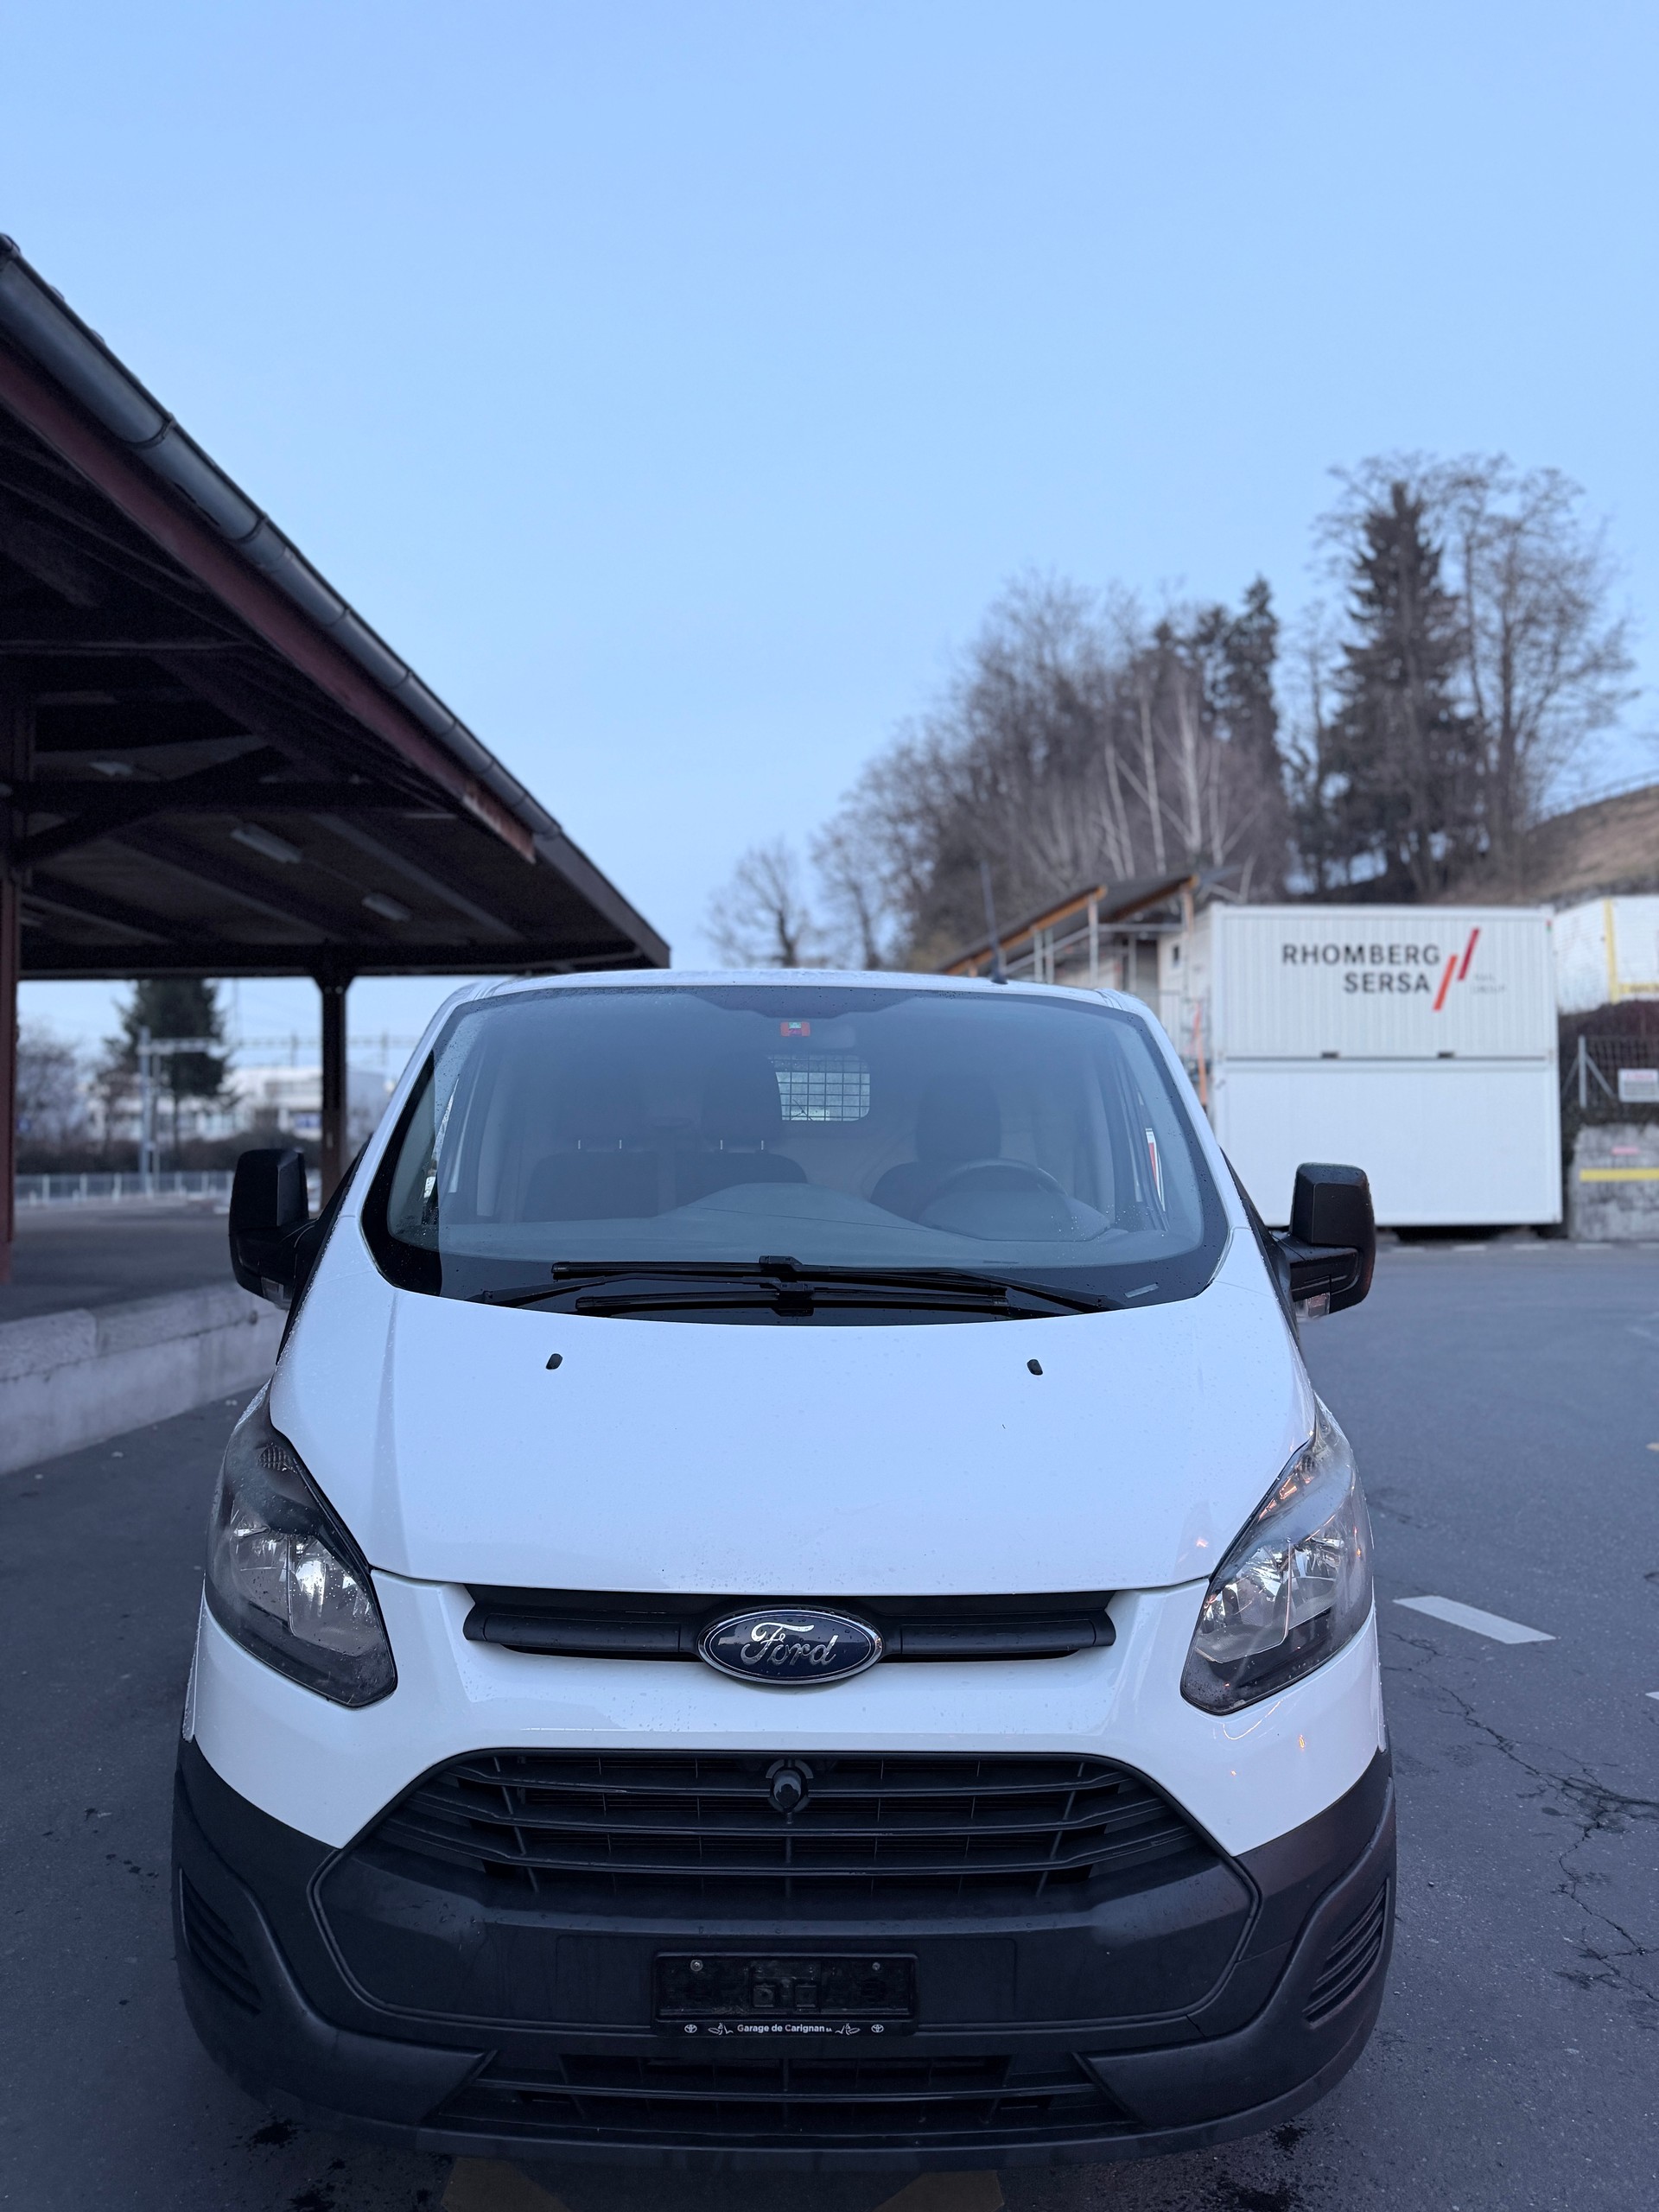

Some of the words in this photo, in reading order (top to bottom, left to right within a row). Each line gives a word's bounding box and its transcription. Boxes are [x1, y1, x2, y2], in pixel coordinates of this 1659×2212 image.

[1283, 944, 1440, 965] RHOMBERG
[1344, 971, 1430, 994] SERSA
[741, 1622, 839, 1666] Ford
[737, 2024, 770, 2033] Garage
[771, 2024, 783, 2032] de
[785, 2024, 825, 2033] Carignan
